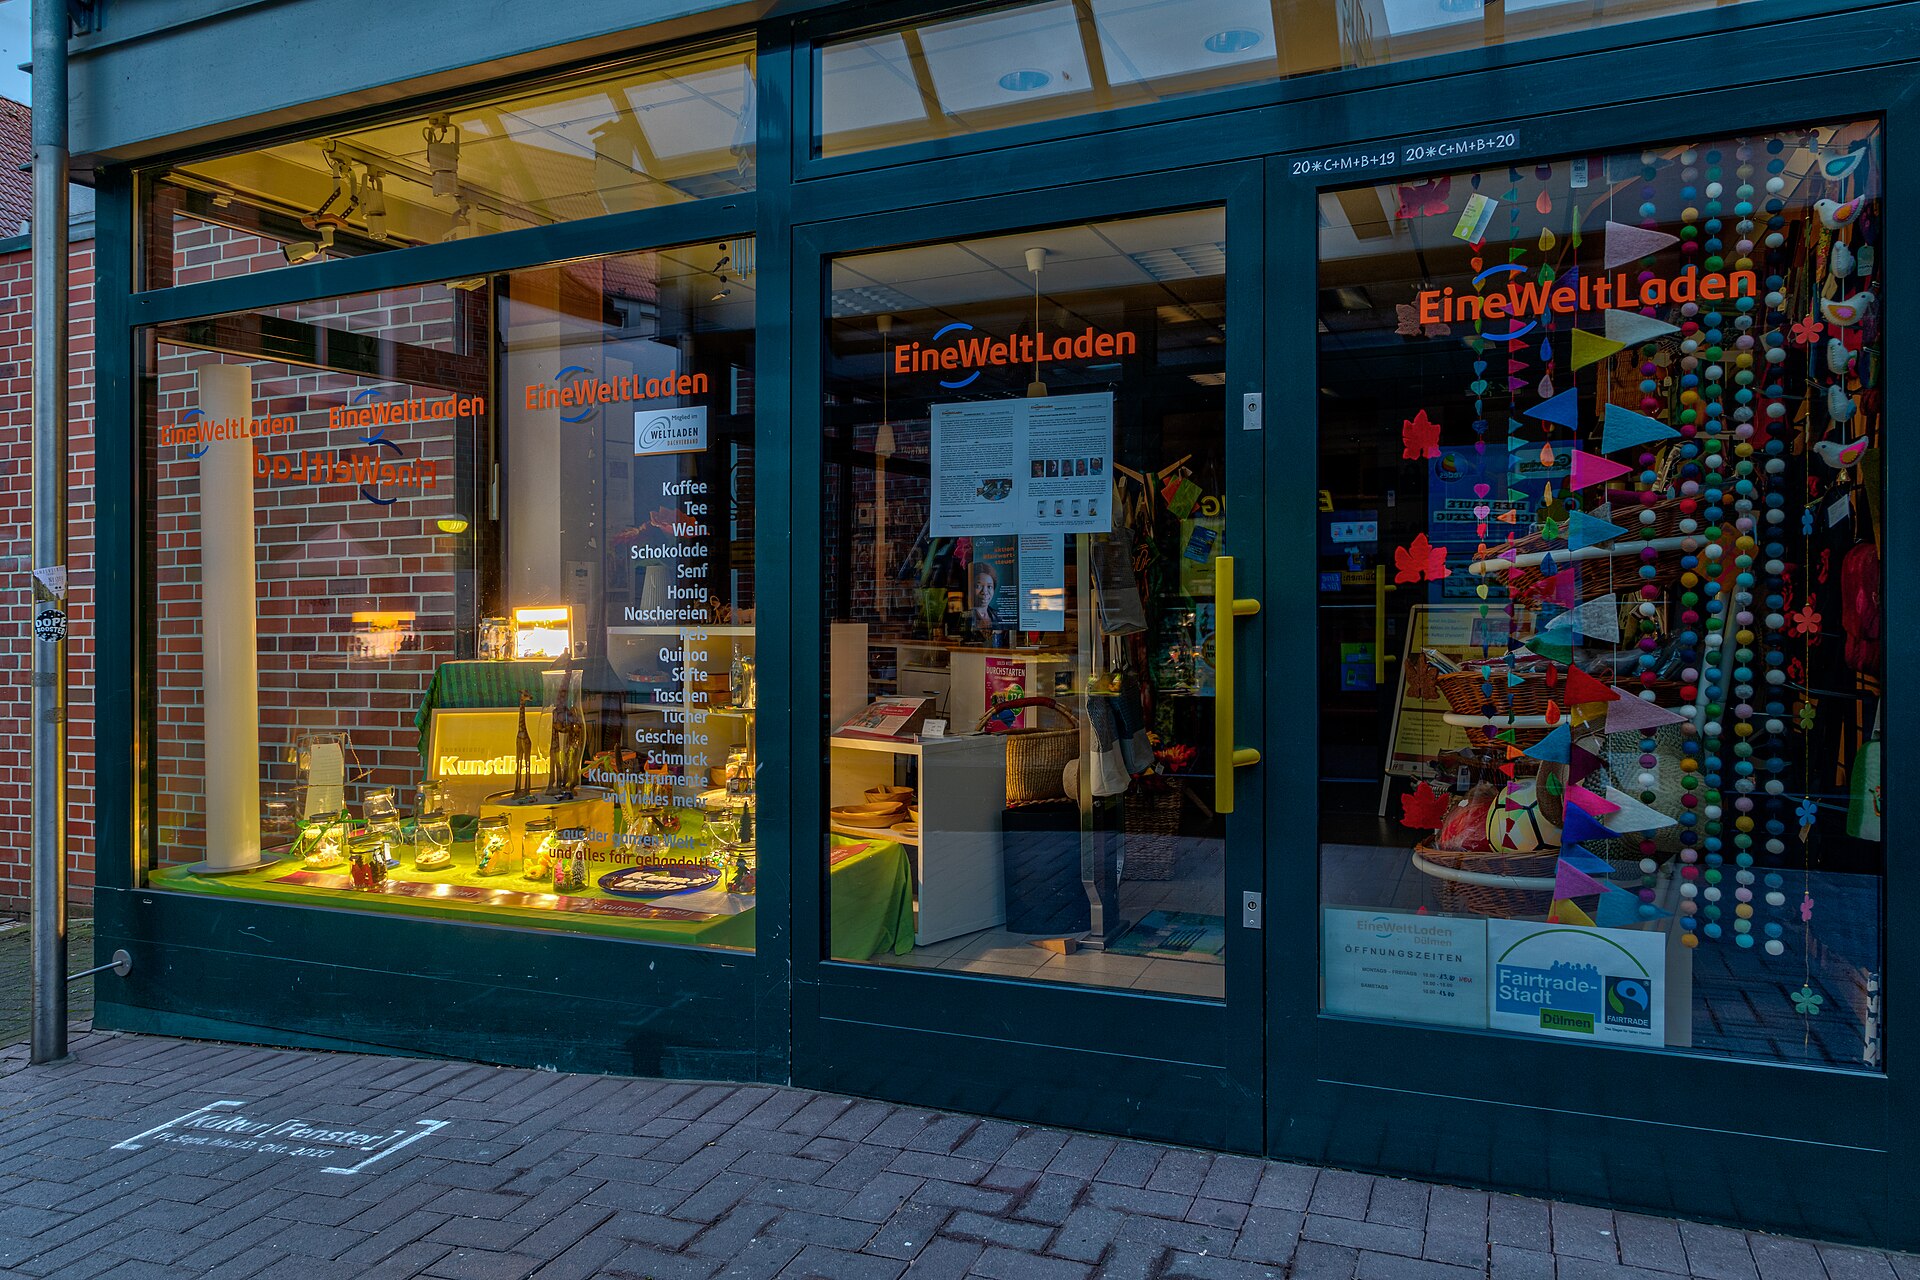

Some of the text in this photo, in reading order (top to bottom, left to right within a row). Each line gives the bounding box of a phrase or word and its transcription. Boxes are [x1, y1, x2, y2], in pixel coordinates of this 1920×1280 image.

[1419, 266, 1757, 325] EineWeltLaden
[894, 327, 1136, 374] EineWeltLaden
[525, 370, 708, 410] EineWeltLaden
[329, 391, 485, 430] EineWeltLaden
[671, 414, 690, 422] Mitglied
[161, 414, 295, 446] EineWeltLaden
[650, 427, 699, 439] WELTLADEN
[662, 480, 708, 496] Kaffee
[684, 501, 708, 516] Tee
[672, 522, 708, 537] Wein
[631, 543, 708, 560] Schokolade
[677, 563, 708, 578] Senf
[667, 585, 708, 602] Honig
[624, 606, 708, 621] Naschereien
[36, 617, 67, 627] DOPE
[680, 627, 708, 641] Reis
[659, 648, 708, 662] Quinoa
[671, 667, 708, 682] Säfte
[986, 666, 1026, 677] DURCHSTARTEN
[653, 688, 708, 703] Taschen
[662, 709, 708, 724] Tücher
[635, 729, 708, 745] Geschenke
[647, 750, 708, 766] Schmuck
[588, 768, 708, 788] Klanginstrumente
[602, 791, 708, 808] und vieles mehr
[588, 829, 609, 842] der
[612, 832, 658, 847] ganzen
[664, 834, 695, 849] Welt
[549, 848, 572, 859] und
[576, 849, 605, 862] alles
[609, 850, 634, 864] fair
[1356, 919, 1453, 938] EineWeltLaden
[1413, 936, 1453, 947] Dülmen
[1344, 944, 1463, 963] ÖFFNUNGSZEITEN
[1500, 969, 1598, 994] Fairtrade-
[1500, 985, 1553, 1006] Stadt
[1543, 1013, 1592, 1029] Dülmen
[1607, 1015, 1649, 1026] FAIRTRADE
